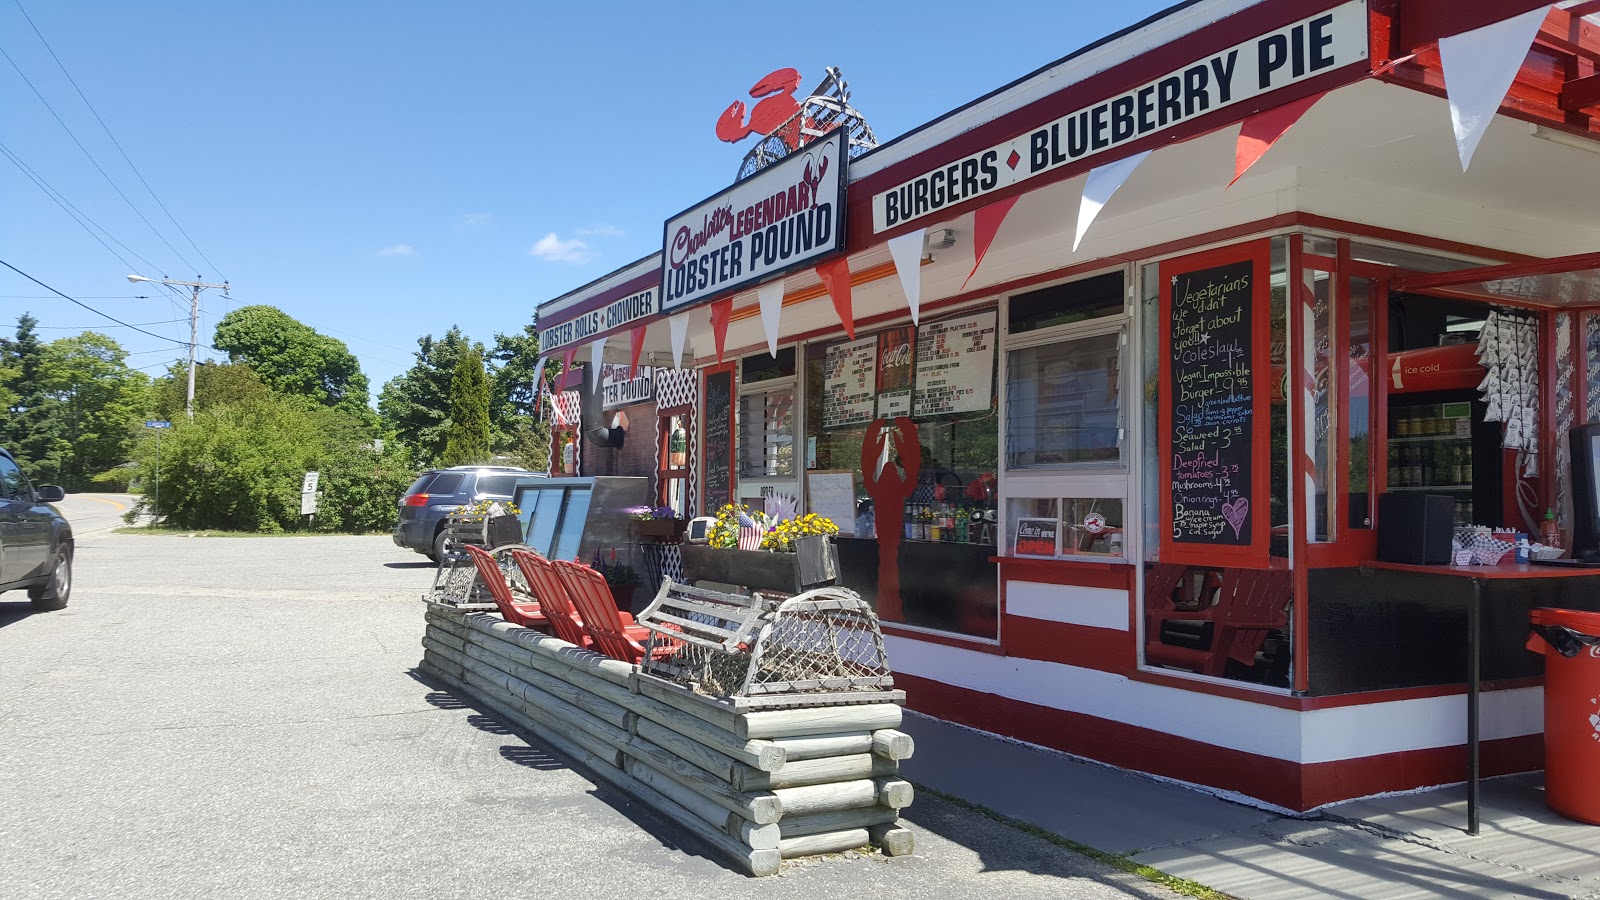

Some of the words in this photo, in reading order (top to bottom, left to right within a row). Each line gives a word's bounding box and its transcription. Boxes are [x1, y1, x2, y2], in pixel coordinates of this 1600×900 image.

[885, 150, 998, 227] BURGERS
[1030, 50, 1239, 173] BLUEBERRY
[1259, 14, 1335, 89] PIE
[671, 198, 732, 269] Charlotte's
[729, 158, 828, 242] LEGENDARY
[667, 240, 742, 301] LOBSTER
[750, 203, 831, 271] POUND
[1176, 275, 1249, 309] Vegetarians
[1198, 294, 1227, 313] didn't
[542, 323, 572, 350] LOBSTER
[575, 312, 598, 339] ROLLS
[607, 291, 652, 328] CHOWDER
[1173, 317, 1205, 340] forget
[1208, 306, 1243, 329] about
[1176, 369, 1202, 388] Vegan
[1199, 362, 1251, 388] Impossible
[1420, 364, 1440, 373] cold
[603, 384, 618, 404] TER
[621, 378, 649, 401] POUND
[1181, 385, 1214, 407] burger
[1176, 405, 1204, 424] Salad
[1173, 426, 1219, 443] Seaweed
[1179, 440, 1205, 454] Salad
[307, 483, 313, 491] 5
[1174, 493, 1201, 504] Onion
[1175, 504, 1211, 520] Banana
[1020, 523, 1034, 535] Come
[1018, 539, 1055, 556] OPEN
